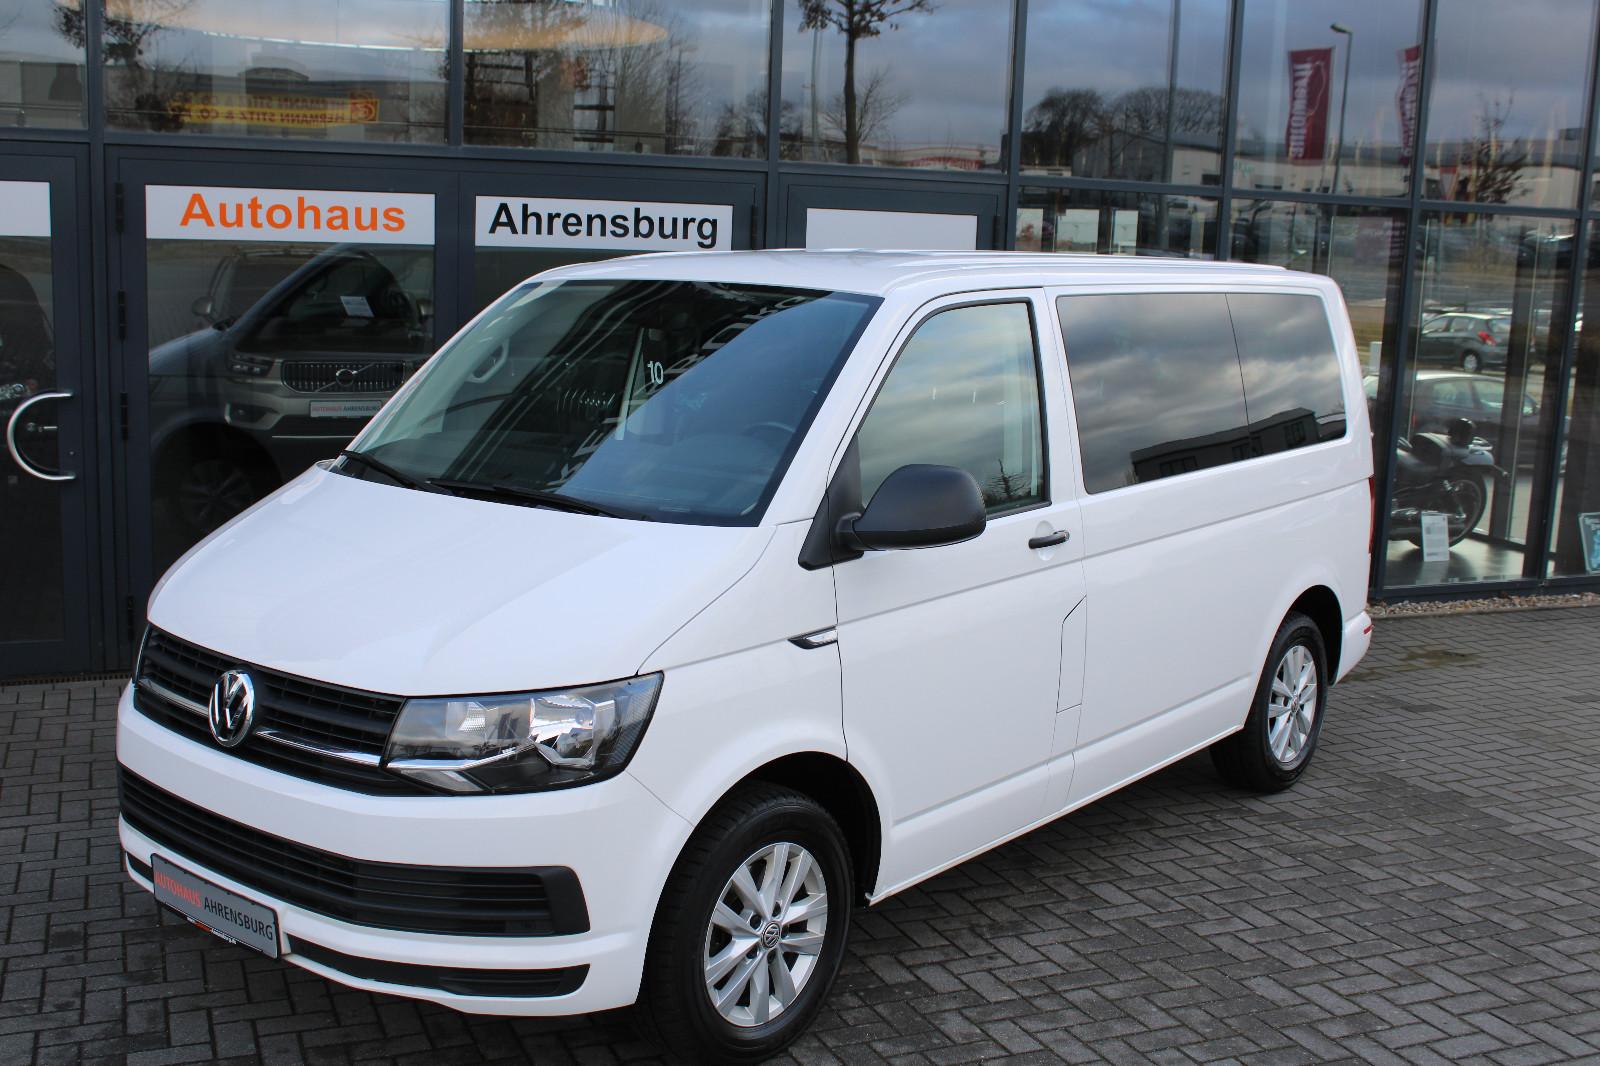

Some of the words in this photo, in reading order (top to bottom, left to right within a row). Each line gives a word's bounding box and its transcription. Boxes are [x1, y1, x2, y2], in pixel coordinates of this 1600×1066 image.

[180, 193, 406, 232] Autohaus
[488, 202, 718, 249] Ahrensburg
[647, 361, 664, 384] 10
[154, 871, 202, 908] AUTOHAUS
[204, 896, 273, 940] AHRENSBURG
